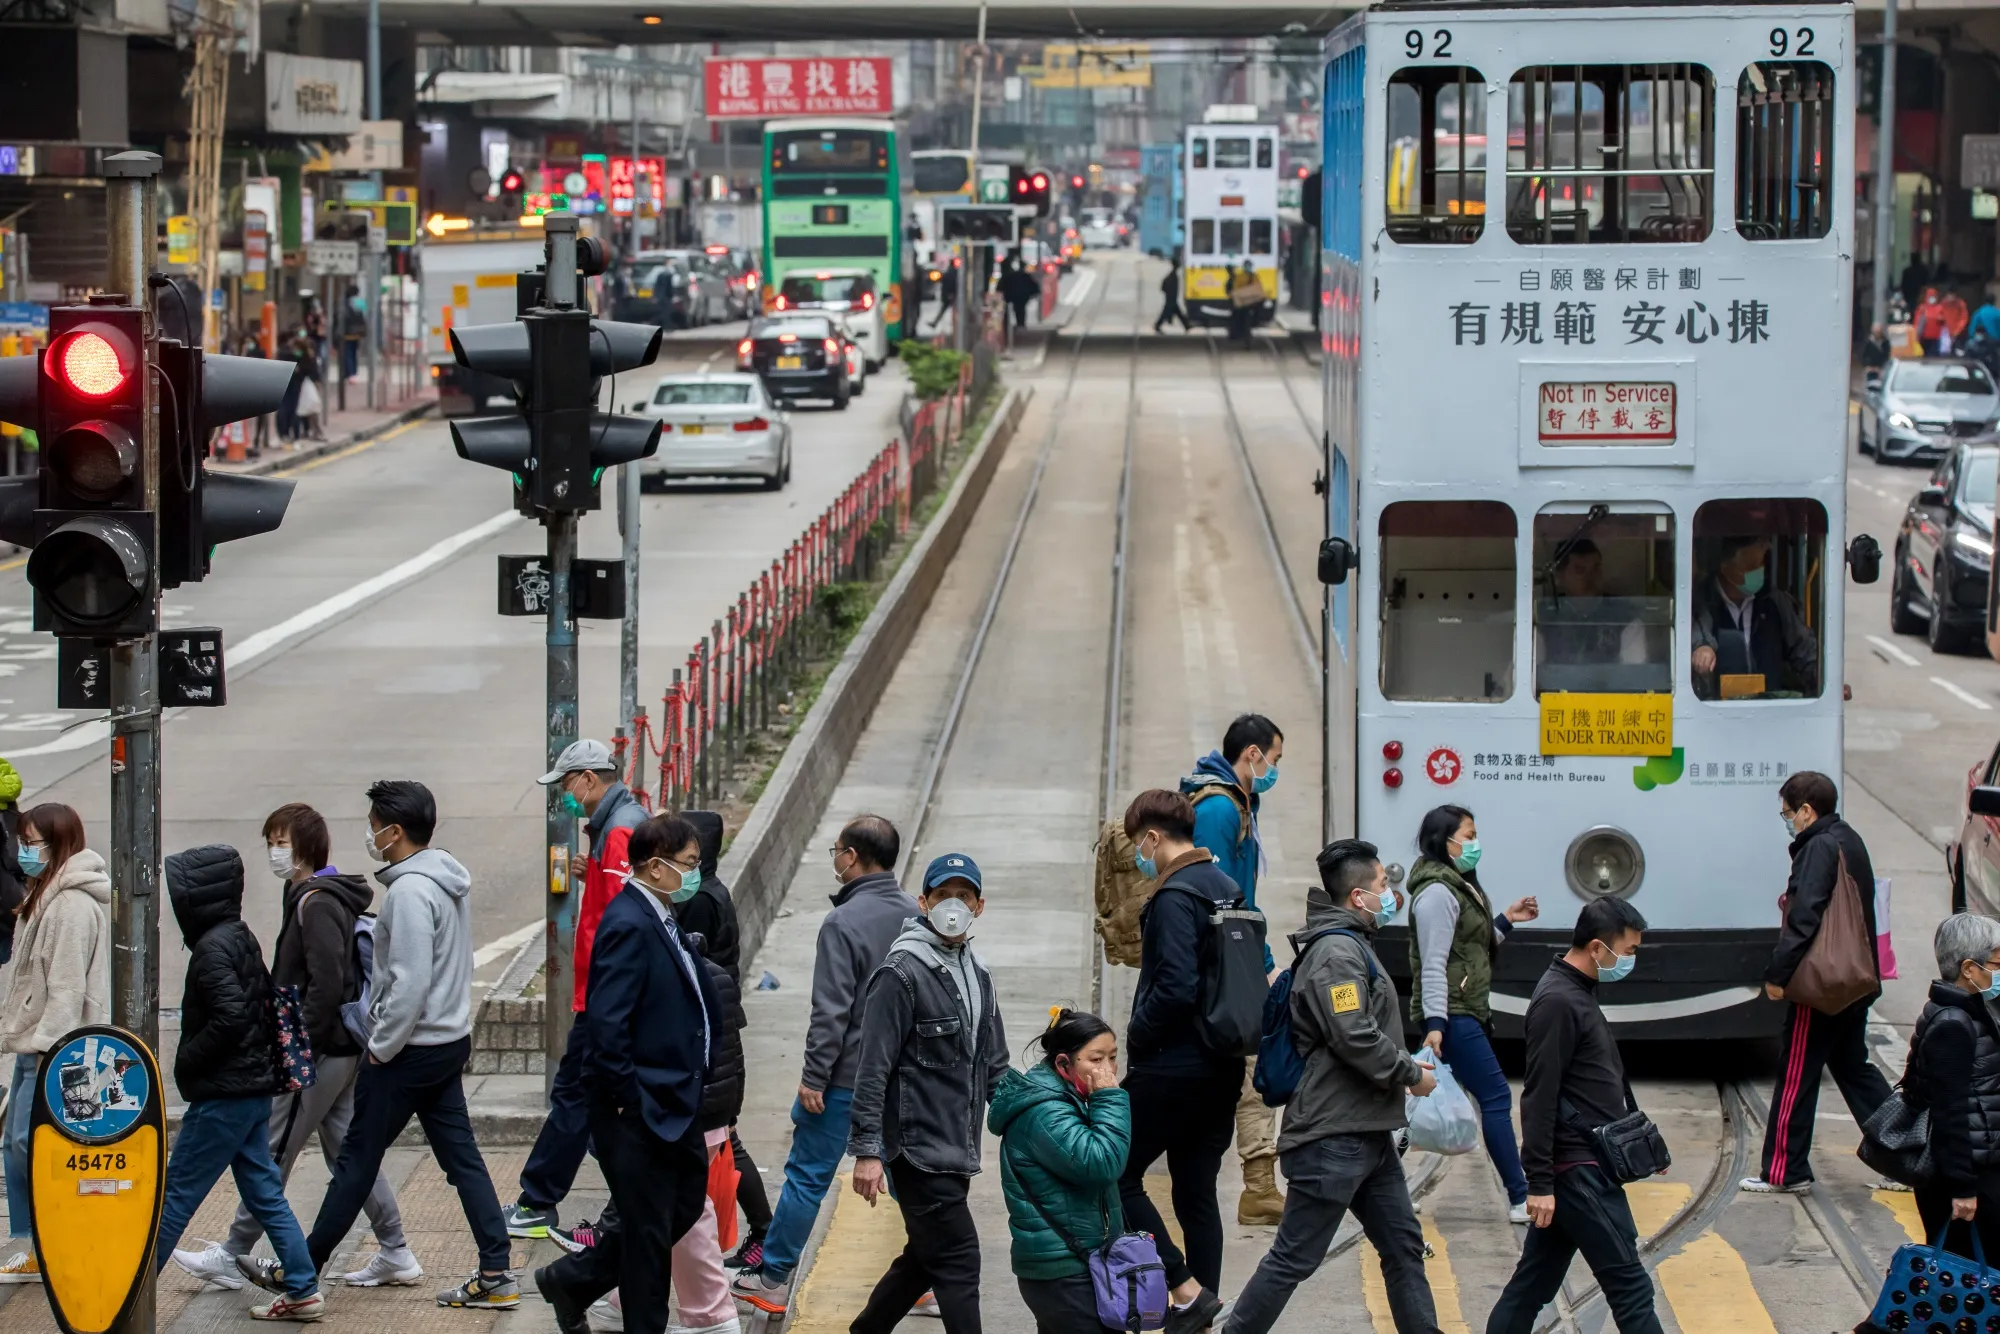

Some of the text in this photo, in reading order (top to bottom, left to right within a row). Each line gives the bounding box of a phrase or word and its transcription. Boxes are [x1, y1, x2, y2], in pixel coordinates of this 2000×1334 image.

[1404, 29, 1453, 58] 92
[1769, 27, 1815, 57] 92
[718, 60, 879, 98] 港豐找換
[805, 97, 880, 111] EXCHANGE
[1519, 267, 1702, 291] 自願醫保計劃
[1448, 300, 1771, 346] 有規範 安心揀
[1542, 382, 1670, 404] Not in Service
[1545, 407, 1667, 430] 暫停載客
[1546, 708, 1666, 728] 司機訓練中
[1546, 729, 1666, 745] UNDER TRAINING
[1473, 770, 1606, 782] Food and Health Bureau
[1689, 761, 1788, 777] 自願醫保計劃
[66, 1153, 127, 1171] 45478
